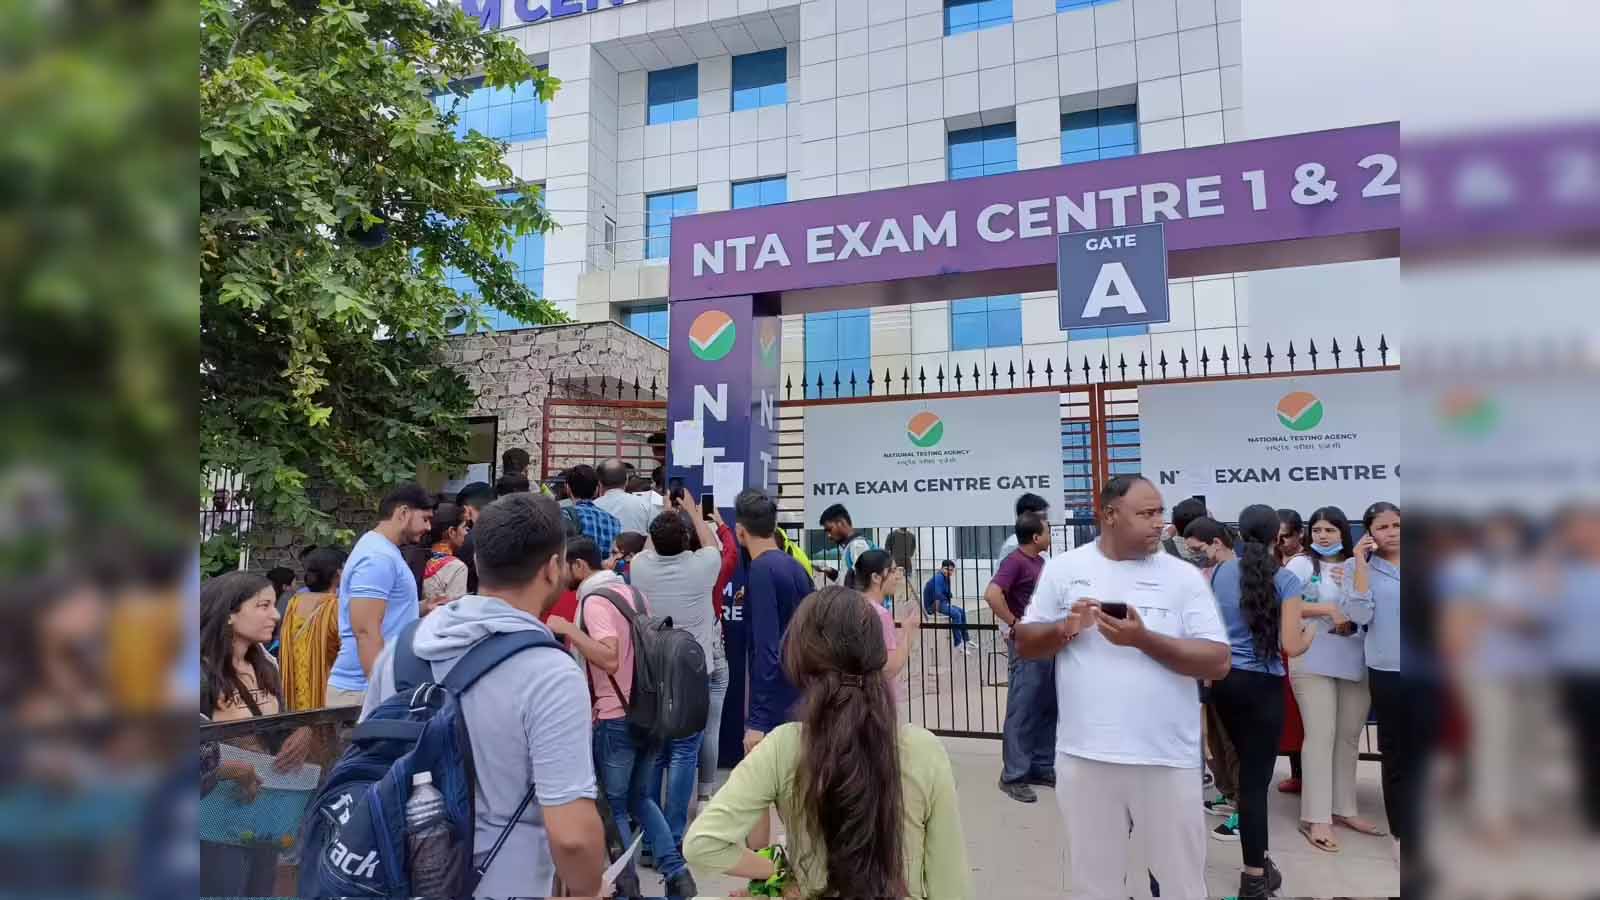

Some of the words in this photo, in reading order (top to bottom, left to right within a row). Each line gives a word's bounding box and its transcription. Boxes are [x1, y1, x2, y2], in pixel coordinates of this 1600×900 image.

[692, 233, 791, 277] NTA
[806, 210, 957, 263] EXAM
[976, 174, 1225, 243] CENTRE
[1242, 170, 1267, 211] 1
[1290, 162, 1337, 205] &
[1357, 153, 1400, 198] 2
[1085, 233, 1137, 251] GATE
[1081, 262, 1147, 319] A
[1215, 469, 1280, 484] EXAM
[1289, 464, 1386, 482] CENTRE
[813, 482, 850, 496] NTA
[855, 479, 908, 494] EXAM
[914, 476, 991, 493] CENTRE
[996, 475, 1051, 490] GATE
